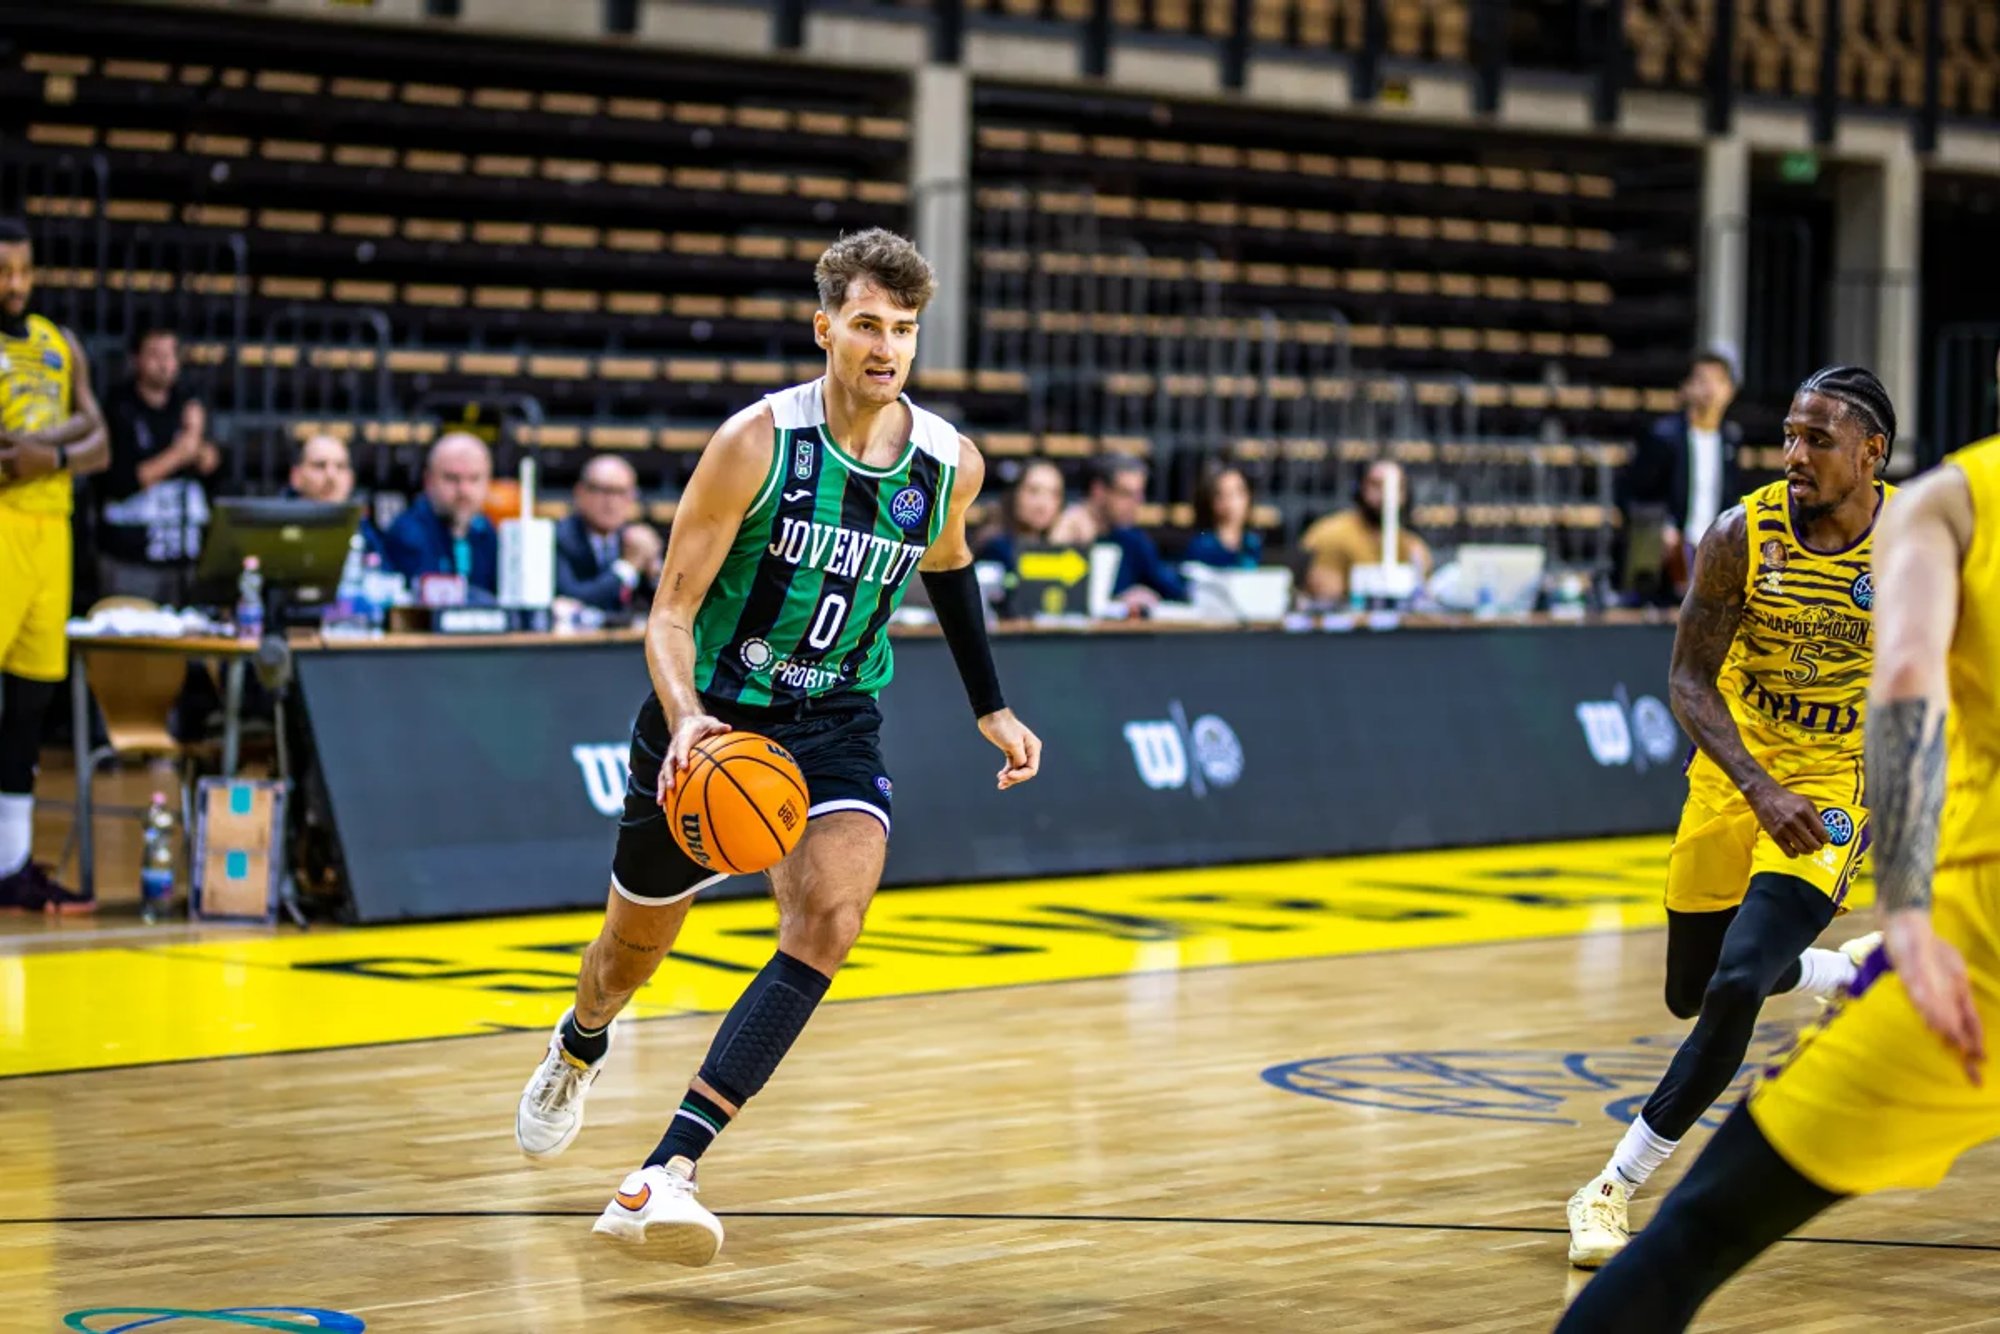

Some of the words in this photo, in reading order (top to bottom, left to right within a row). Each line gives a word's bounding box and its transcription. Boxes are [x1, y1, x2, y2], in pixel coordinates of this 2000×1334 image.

[768, 517, 925, 586] JOVENTUT
[809, 593, 847, 649] 0
[1823, 620, 1871, 645] HOLON
[768, 660, 847, 688] PROBIT
[1783, 641, 1826, 688] 5
